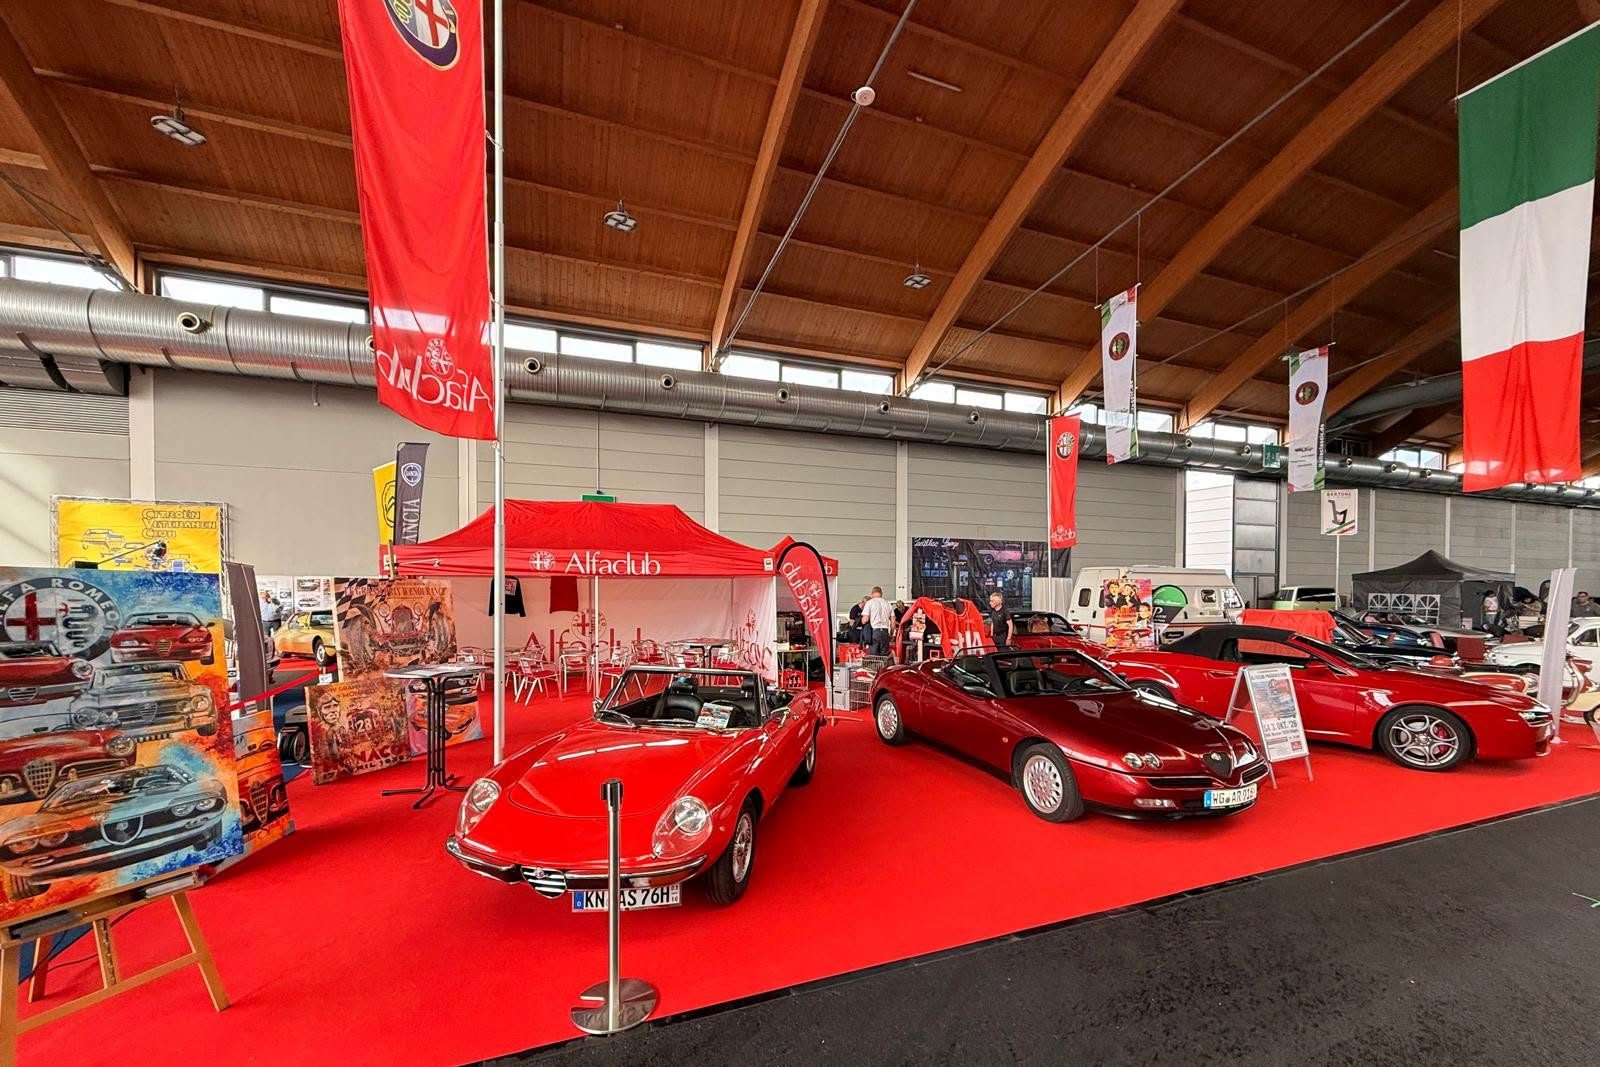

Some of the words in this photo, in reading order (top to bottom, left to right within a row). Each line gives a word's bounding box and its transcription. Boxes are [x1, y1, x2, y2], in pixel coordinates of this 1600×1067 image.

[402, 498, 420, 543] ANCIA
[564, 551, 661, 575] Alfaclub
[0, 583, 36, 625] LFA
[51, 578, 120, 620] ROMEO
[357, 718, 374, 733] 28
[585, 889, 605, 909] KN
[620, 889, 637, 906] AS
[641, 888, 670, 905] 76H
